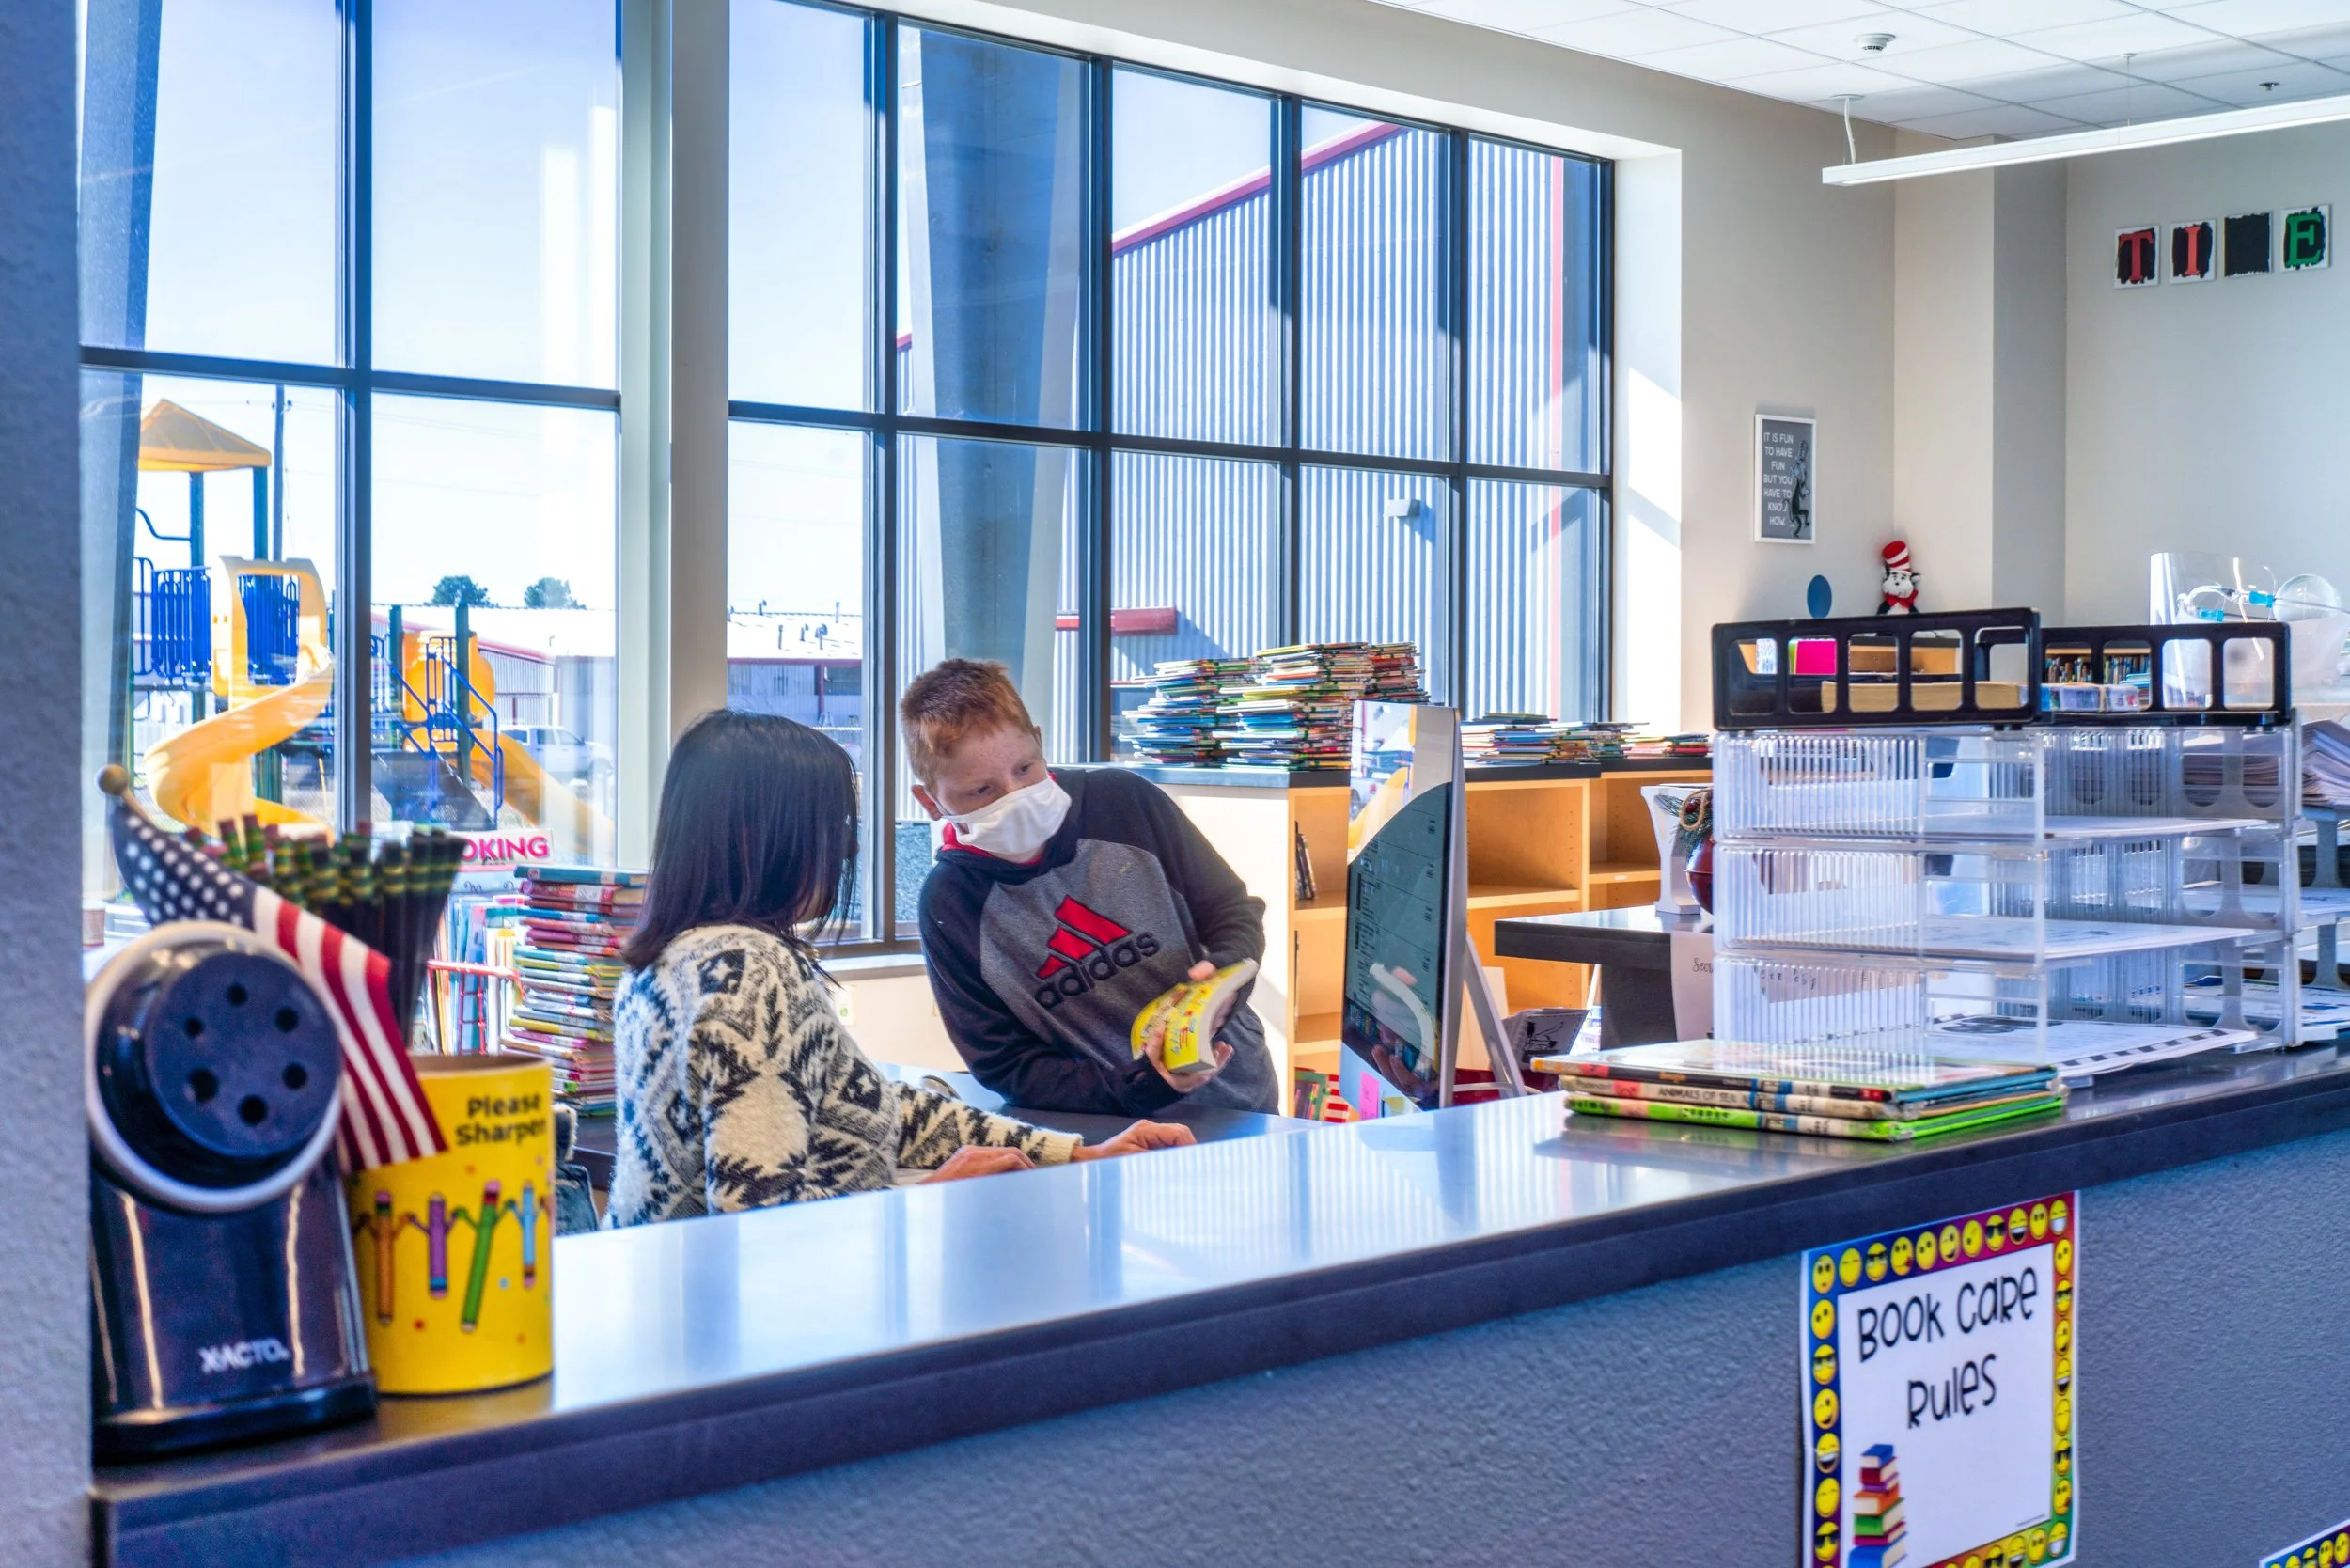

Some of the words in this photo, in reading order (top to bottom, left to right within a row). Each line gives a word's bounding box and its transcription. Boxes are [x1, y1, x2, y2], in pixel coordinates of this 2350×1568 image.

[1763, 432, 1770, 442] IT
[1772, 432, 1778, 443] IS
[1779, 433, 1794, 444] FUN
[1764, 446, 1774, 456] TO
[1776, 447, 1793, 458] HAVE
[1771, 461, 1786, 471] FUN
[1763, 473, 1778, 484] BUT
[1778, 475, 1793, 485] YOU
[1763, 488, 1781, 498] HAVE
[1782, 489, 1793, 499] TO
[461, 836, 549, 861] OKING
[1035, 932, 1160, 1009] adidas
[1658, 1087, 1700, 1100] ANIMALS
[1702, 1090, 1716, 1100] OF
[467, 1092, 542, 1119] Please
